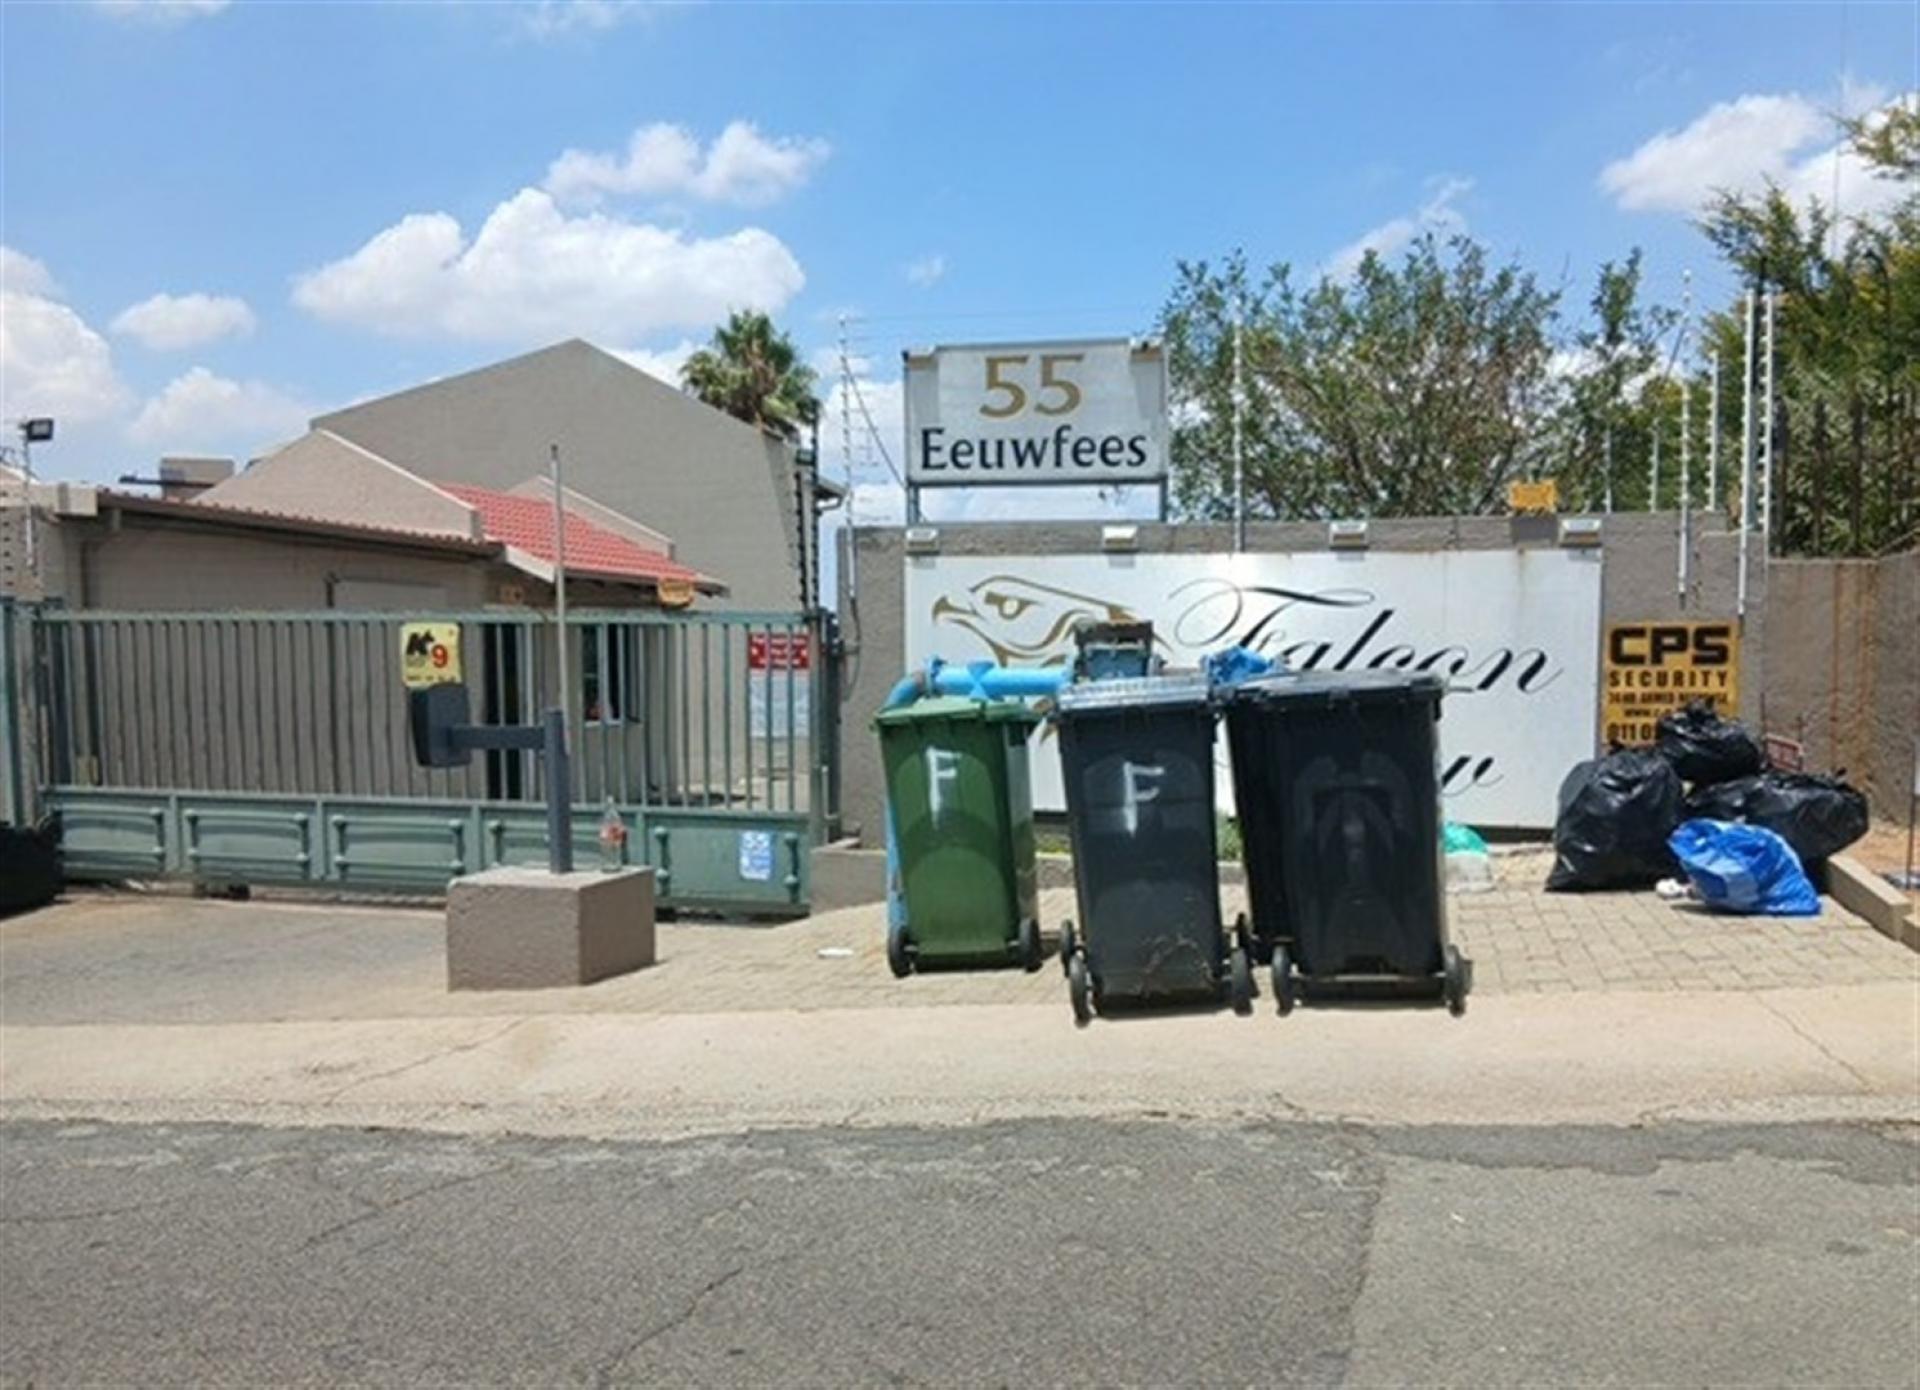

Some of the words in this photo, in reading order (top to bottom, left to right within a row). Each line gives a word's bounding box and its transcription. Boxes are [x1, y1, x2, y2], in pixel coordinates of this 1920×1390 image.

[979, 353, 1084, 417] 55
[921, 424, 1147, 469] Eeuwfees
[1610, 627, 1729, 665] CPS
[1609, 669, 1728, 687] SECURITY
[926, 746, 962, 830] F
[1123, 761, 1164, 837] F
